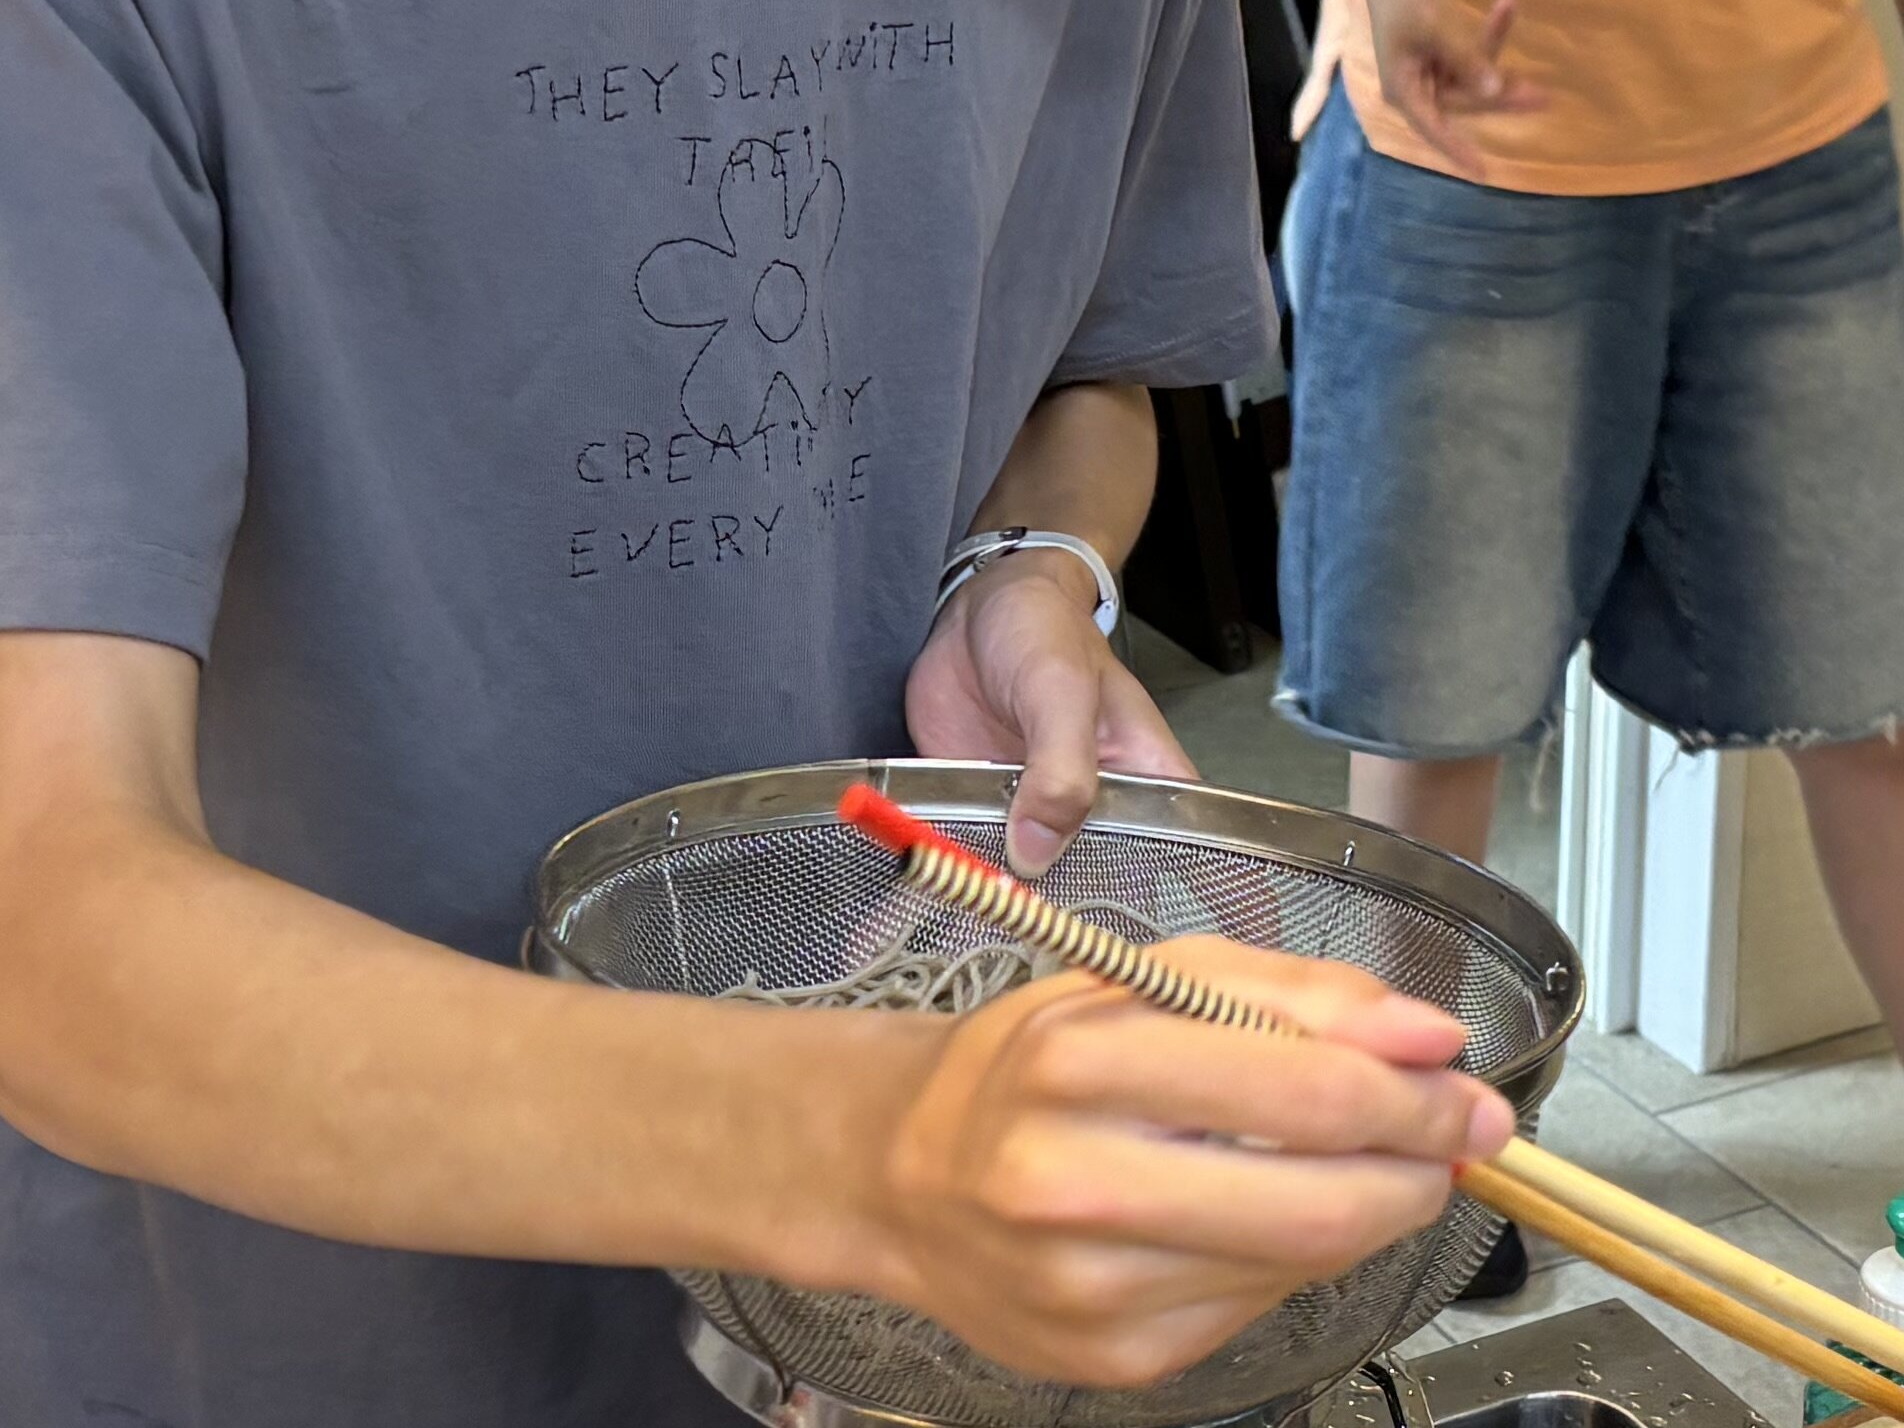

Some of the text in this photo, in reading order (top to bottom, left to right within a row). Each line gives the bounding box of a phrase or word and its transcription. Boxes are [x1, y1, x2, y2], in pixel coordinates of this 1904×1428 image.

[515, 62, 680, 122] THEY
[708, 39, 831, 100] SLAY
[571, 504, 785, 578] EVERY
